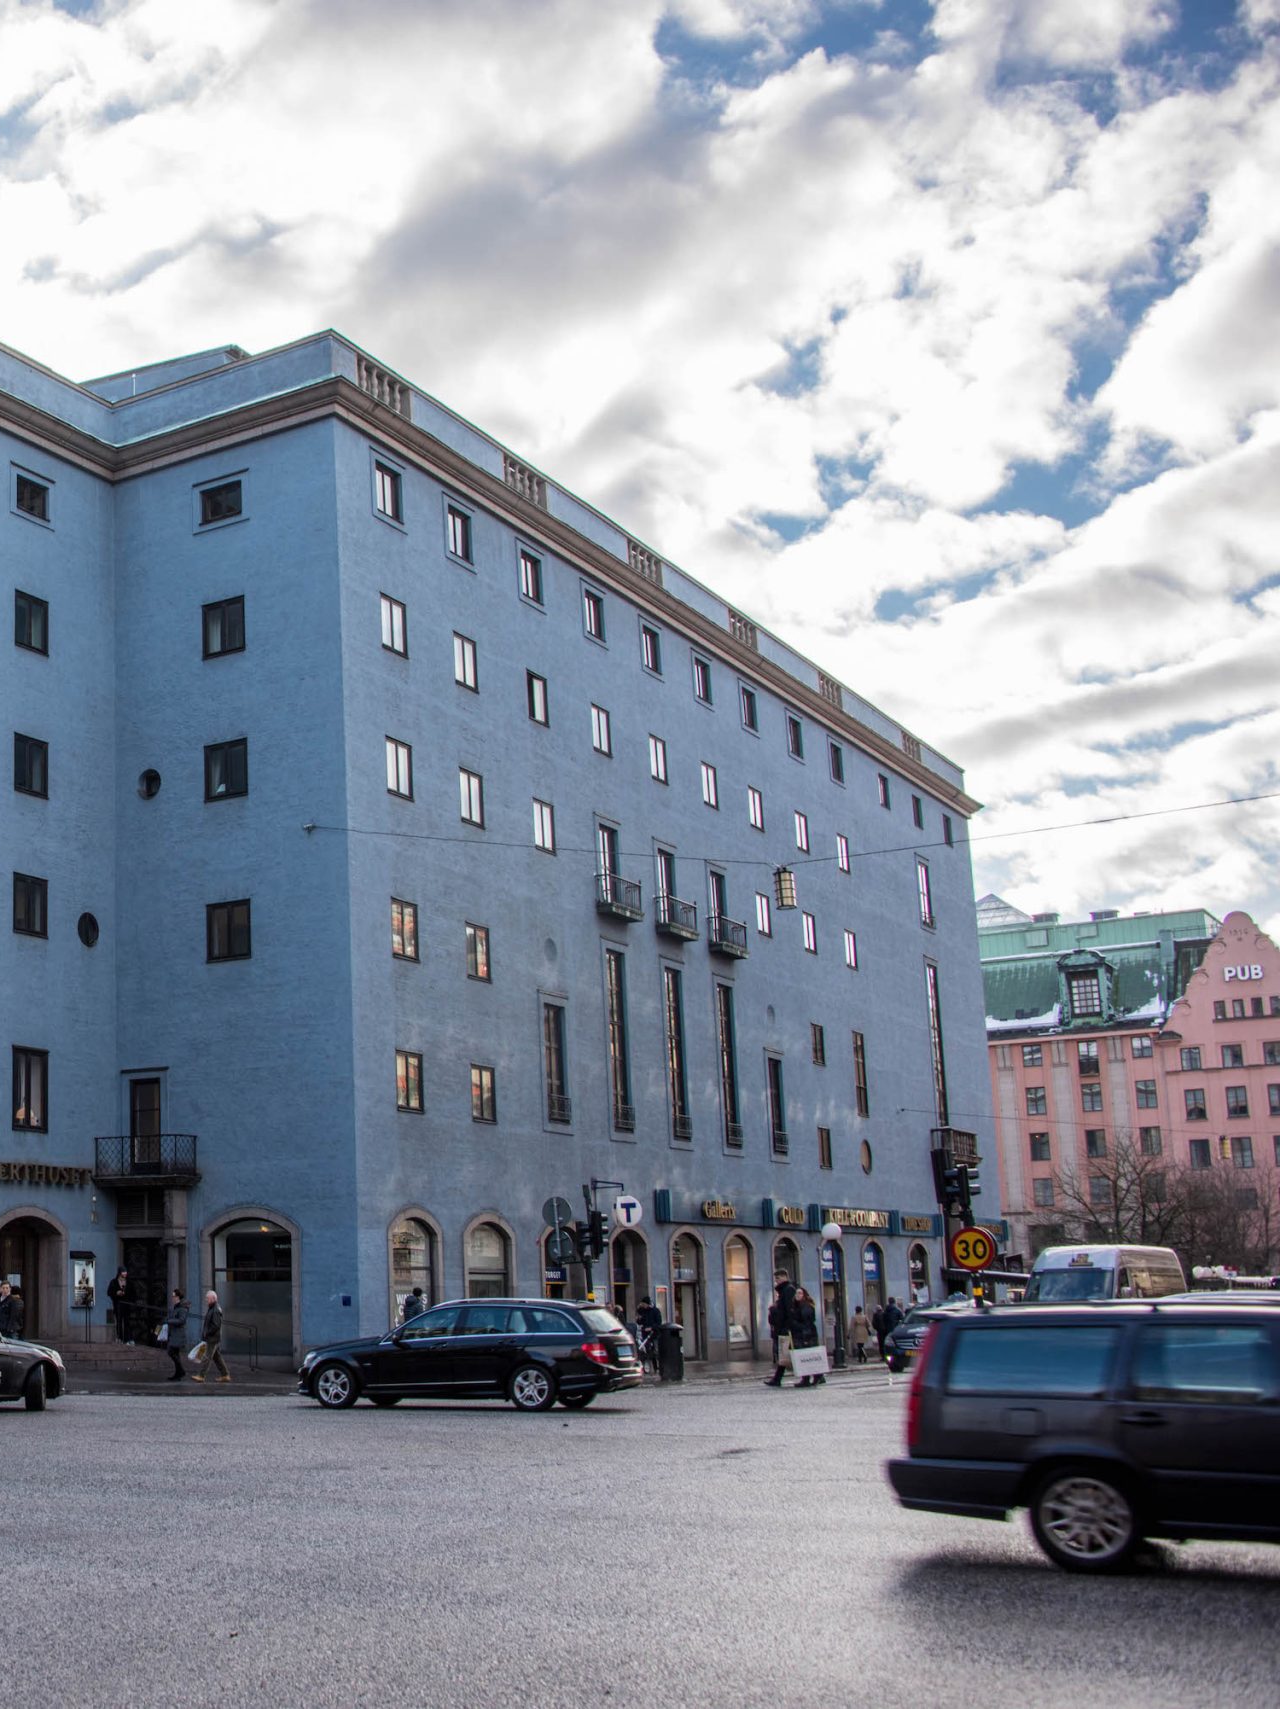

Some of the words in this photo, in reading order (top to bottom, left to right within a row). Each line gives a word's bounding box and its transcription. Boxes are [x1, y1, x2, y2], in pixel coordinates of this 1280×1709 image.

[1223, 965, 1263, 982] PUB
[621, 1202, 637, 1223] T
[704, 1200, 736, 1220] Gallerix
[781, 1206, 804, 1224] GULD
[856, 1210, 889, 1228] COMPANY
[958, 1238, 987, 1260] 30
